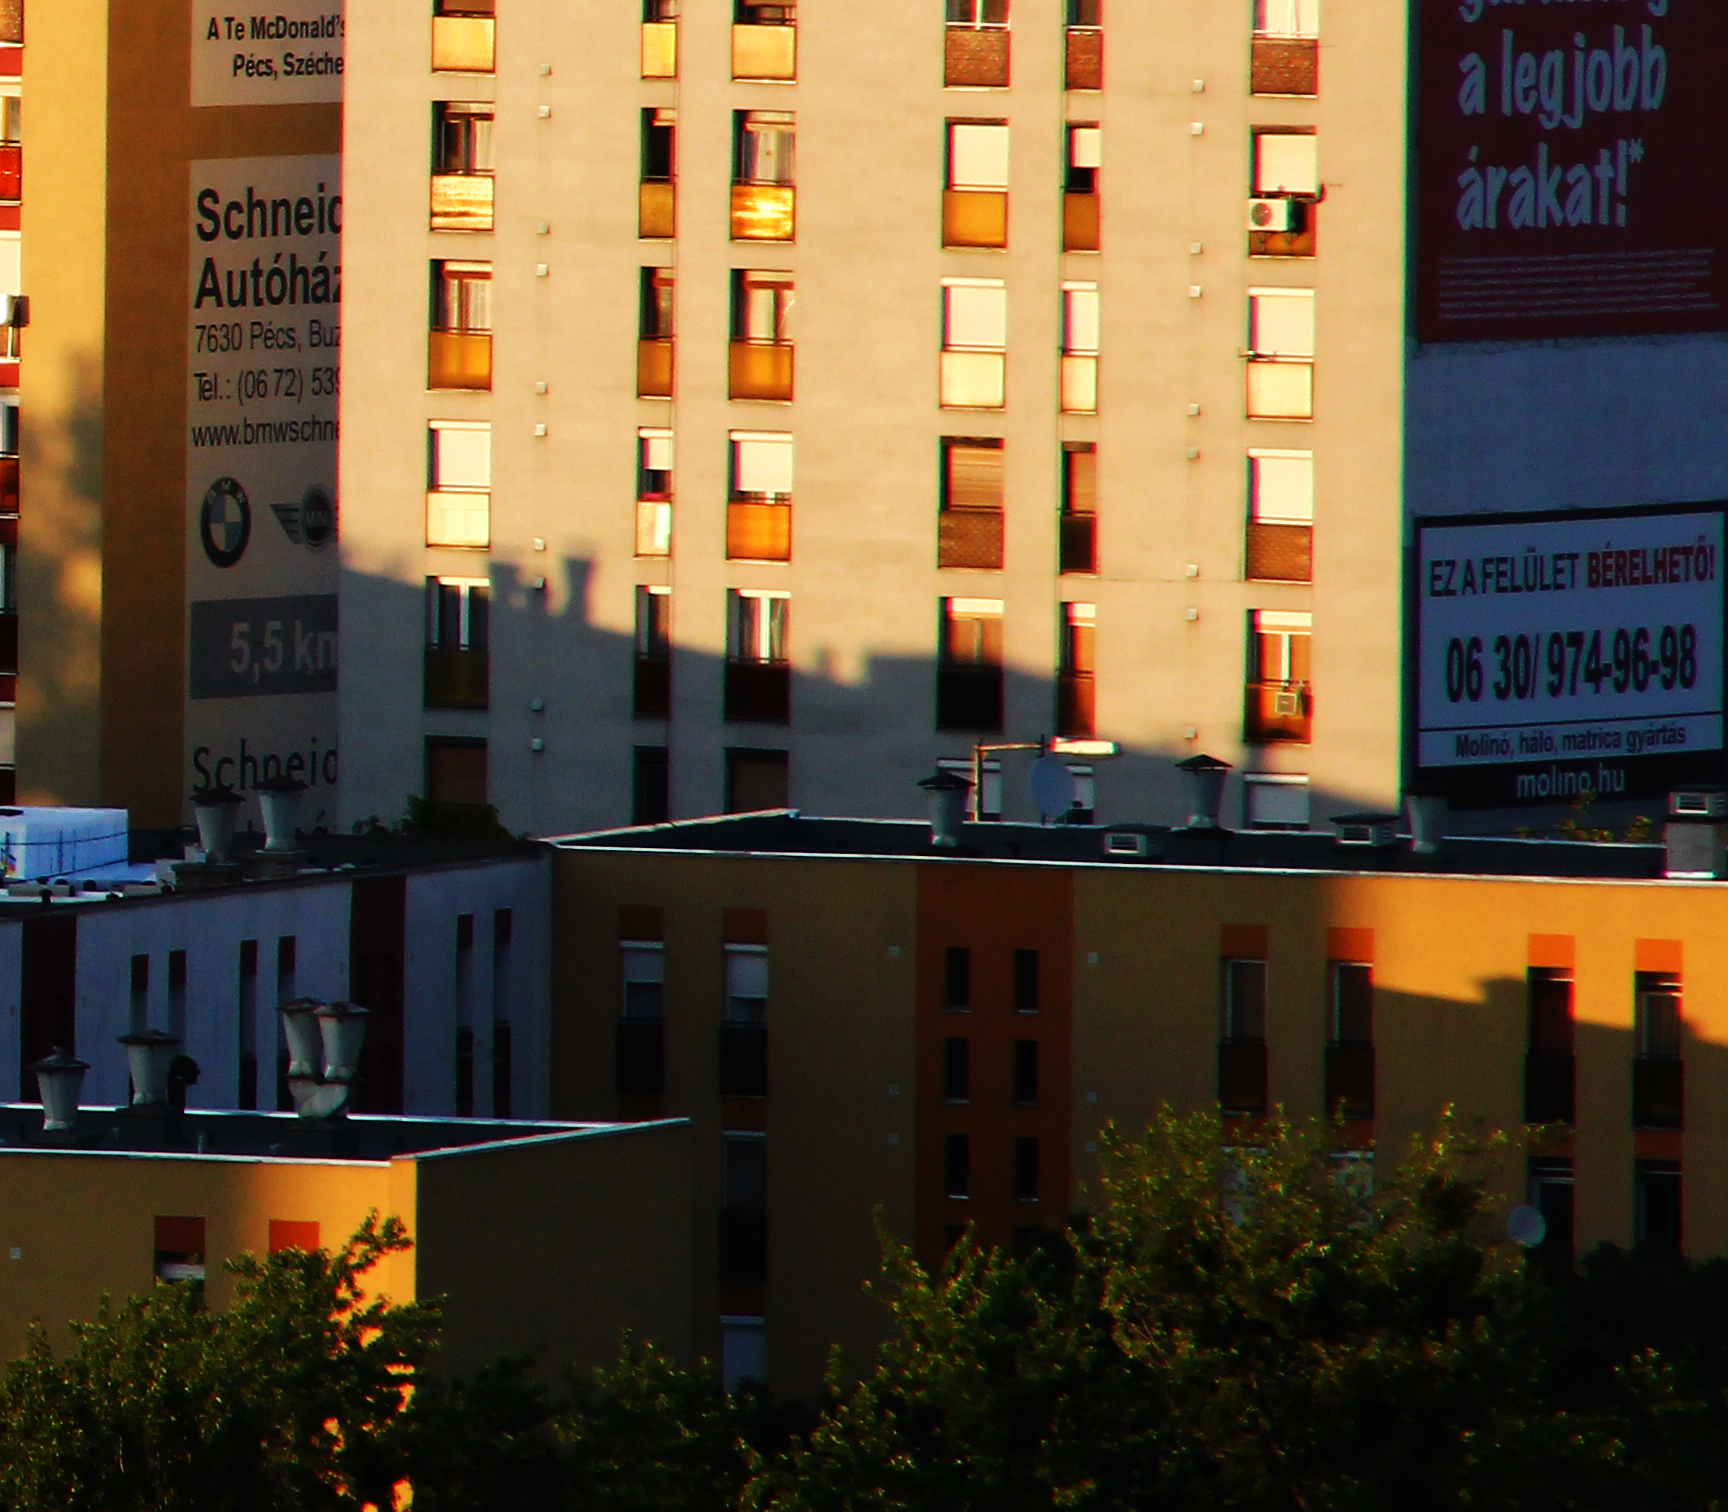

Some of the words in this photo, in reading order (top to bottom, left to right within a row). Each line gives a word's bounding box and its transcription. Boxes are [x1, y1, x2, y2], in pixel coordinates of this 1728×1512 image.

[207, 17, 219, 40] A
[224, 17, 245, 40] Te
[233, 53, 278, 81] Pécs,
[1458, 51, 1487, 116] a
[1501, 23, 1668, 130] legjobb
[196, 323, 242, 353] 7630
[250, 321, 301, 352] Pécs,
[194, 372, 231, 402] Tel.:
[238, 370, 268, 406] (06
[274, 368, 304, 403] 72)
[1430, 559, 1457, 597] EZ
[1461, 558, 1478, 595] A
[1482, 546, 1579, 594] FELÜLET
[1588, 535, 1716, 588] BÉRELHETŐ!
[230, 619, 283, 683] 5,5
[1447, 637, 1484, 703] 06
[1494, 633, 1540, 700] 30/
[1547, 624, 1697, 697] 974-96-98
[1562, 726, 1622, 751] matrica
[1626, 722, 1686, 755] gyártás
